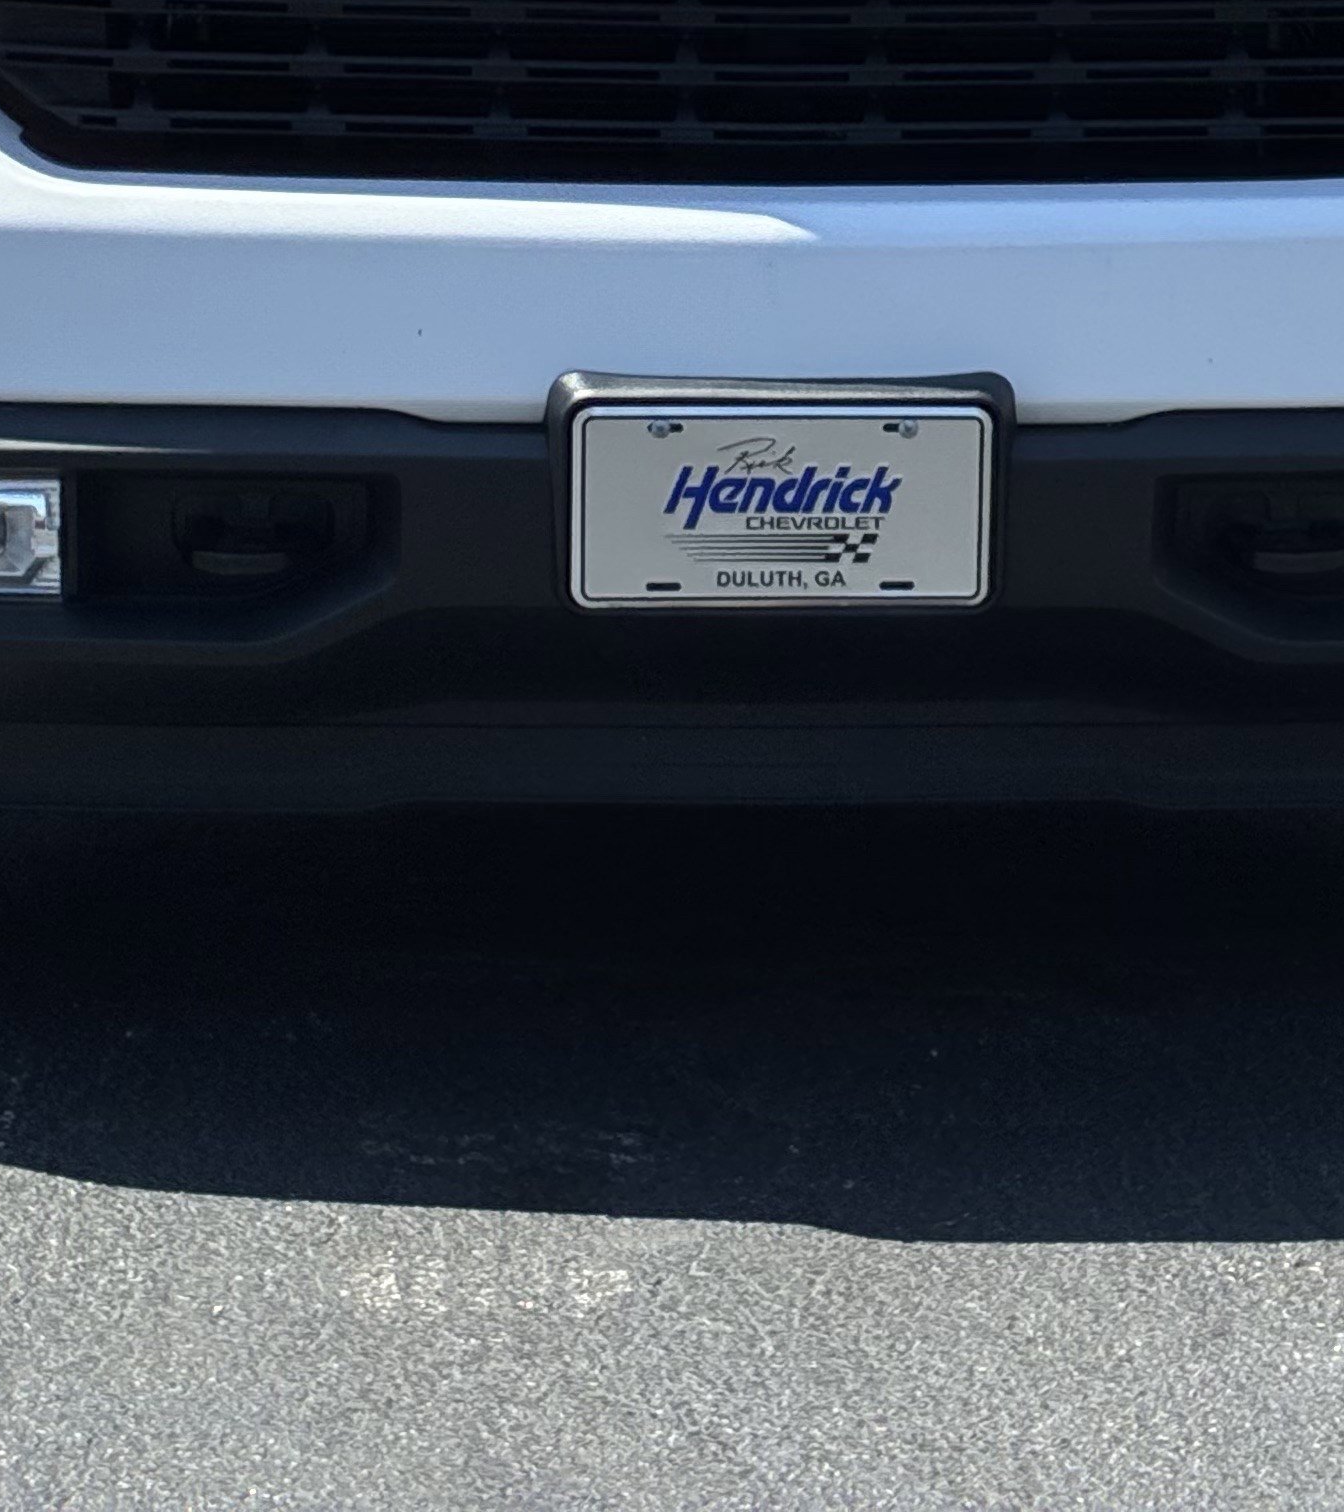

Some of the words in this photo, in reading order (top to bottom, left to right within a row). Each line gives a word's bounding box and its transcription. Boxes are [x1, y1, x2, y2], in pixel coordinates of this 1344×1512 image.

[663, 462, 903, 530] Hendrick
[745, 516, 885, 530] CHEVROLET
[716, 570, 808, 588] DULUTH,
[814, 570, 846, 588] GA
